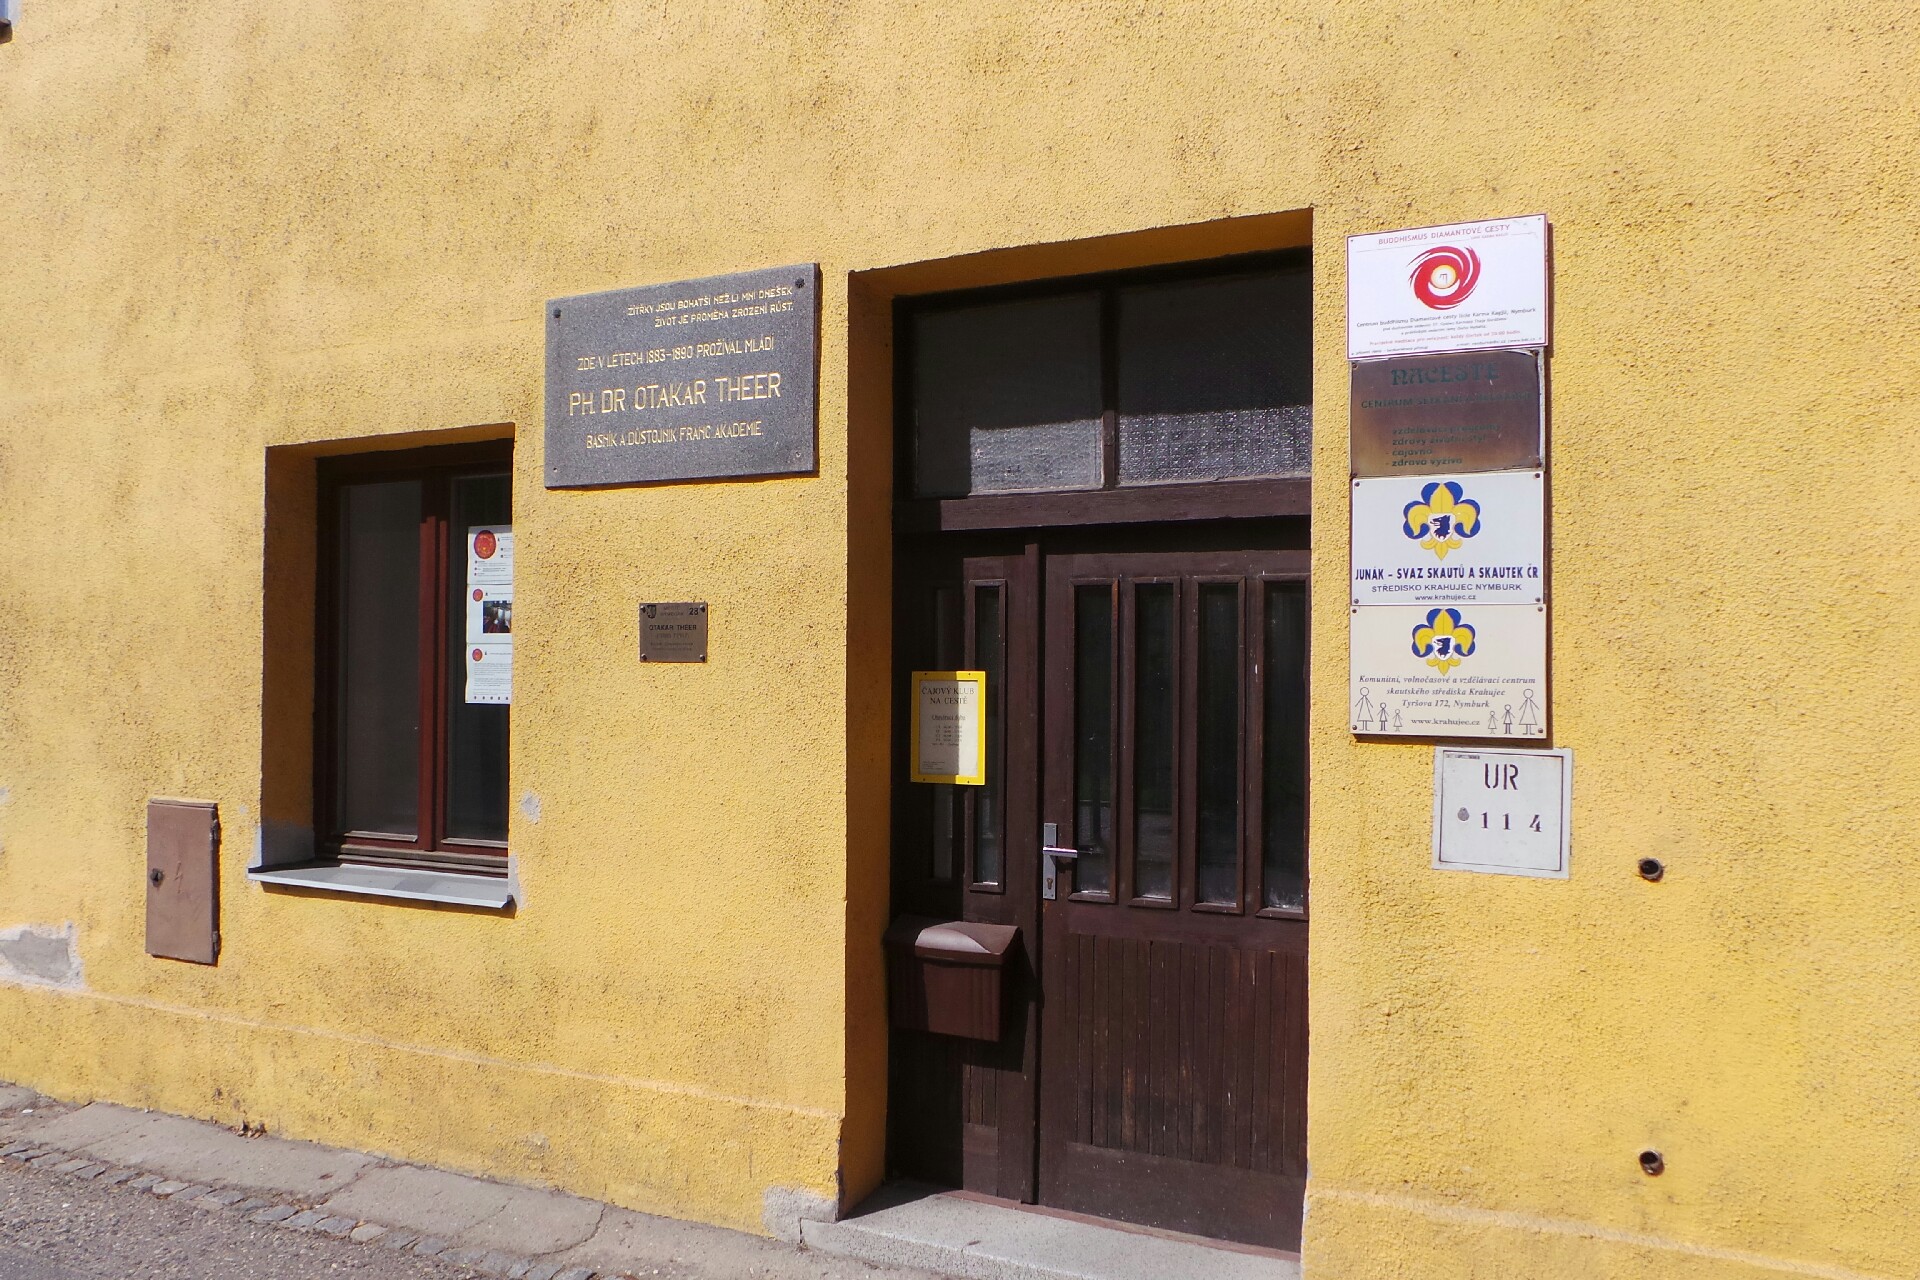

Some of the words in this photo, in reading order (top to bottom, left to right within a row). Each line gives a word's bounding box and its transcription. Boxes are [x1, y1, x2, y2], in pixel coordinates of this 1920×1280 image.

[1378, 233, 1428, 245] BUDDHISMUS
[1431, 226, 1481, 239] DIAMANTOVÉ
[1485, 224, 1510, 233] CESTY
[656, 303, 675, 313] JSOU
[678, 295, 711, 309] BOHATŠÍ
[759, 285, 793, 299] DNEŠEK
[655, 316, 677, 328] ŽIVOT
[678, 315, 688, 325] JE
[691, 309, 729, 323] PROMĚNA
[732, 302, 767, 318] ZROZENÍ
[1410, 315, 1441, 323] Diamantové
[1510, 307, 1536, 315] Nymburk
[577, 357, 596, 371] ZDE
[599, 355, 605, 369] V
[696, 338, 742, 359] PROŽÍVAL
[744, 333, 775, 353] MLÁDÍ
[601, 388, 626, 414] DR
[634, 380, 707, 411] OTAKAR
[715, 372, 781, 402] THEER
[1362, 397, 1414, 409] CENTRUM
[620, 434, 626, 446] A
[627, 425, 677, 446] DŮSTOJNÍK
[1355, 566, 1384, 580] JUNÁK
[1397, 567, 1424, 579] SVAZ
[1427, 564, 1465, 579] SKAUTŮ
[1468, 567, 1475, 579] A
[1479, 566, 1523, 579] SKAUTEK
[1527, 563, 1539, 579] ČR
[1371, 583, 1421, 593] STŘEDISKO
[1424, 583, 1473, 591] KRAHUJEC
[1475, 583, 1522, 591] NYMBURK
[1359, 675, 1401, 684] Komunitní,
[1403, 675, 1450, 684] volnočasové
[1459, 675, 1500, 684] vzdělávací
[921, 686, 951, 695] ČAJOVÝ
[953, 687, 975, 695] KLUB
[1386, 687, 1429, 696] skautského
[1431, 688, 1466, 696] střediska
[1468, 688, 1506, 698] Krahujec
[944, 696, 968, 705] CESTĚ
[1402, 699, 1432, 709] Tyršova
[1435, 699, 1451, 709] 172,
[1453, 700, 1490, 709] Nymburk
[1411, 718, 1481, 726] www.krahujec.cz
[1484, 763, 1519, 790] UR
